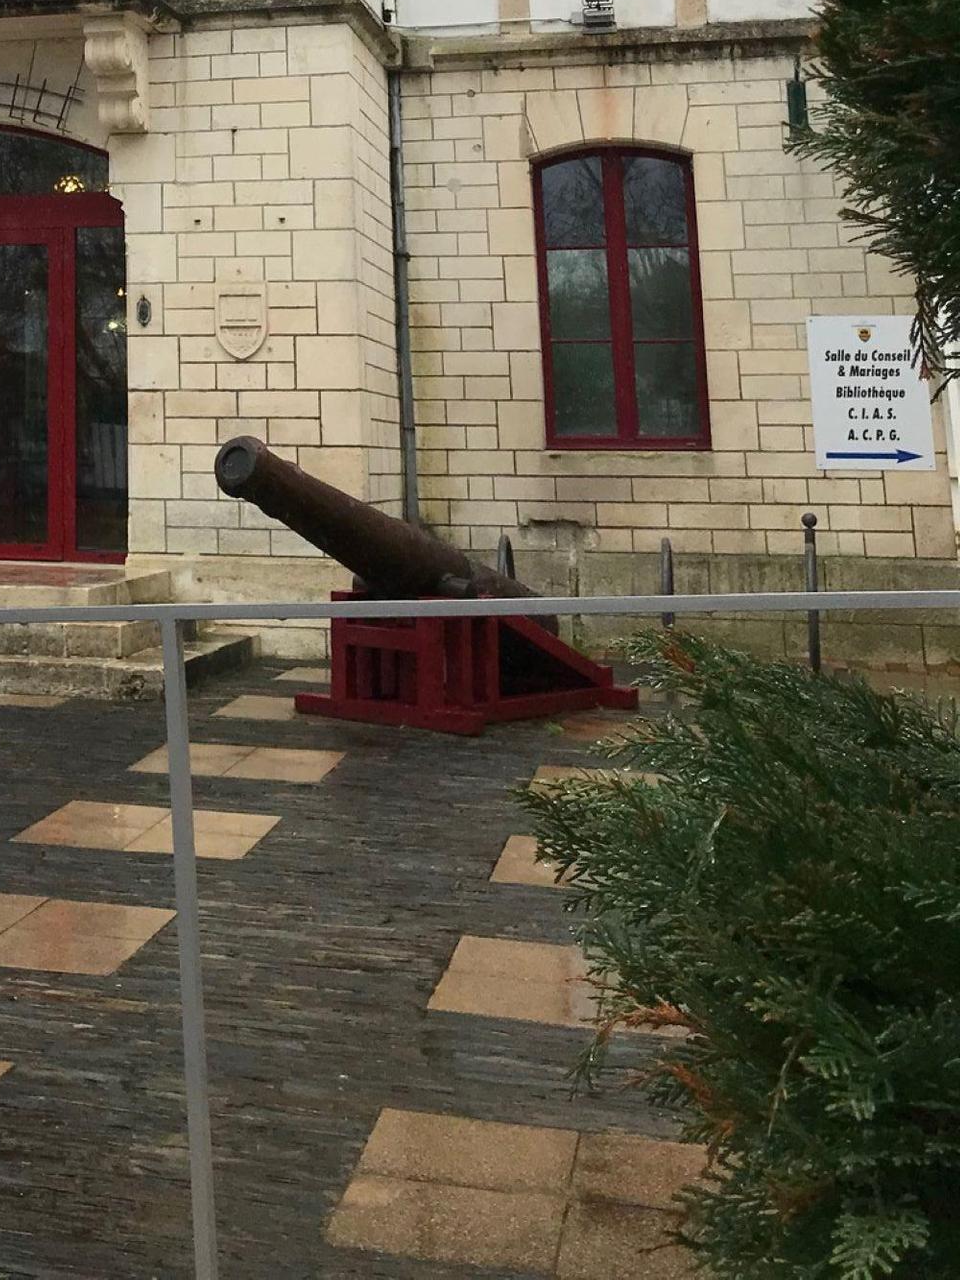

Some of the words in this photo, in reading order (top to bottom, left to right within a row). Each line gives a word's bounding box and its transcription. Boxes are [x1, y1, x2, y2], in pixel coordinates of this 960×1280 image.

[825, 350, 851, 362] Salle
[854, 350, 868, 362] du
[871, 349, 911, 362] Conseil
[837, 366, 846, 377] &
[849, 365, 901, 380] Mariages
[836, 386, 906, 401] Bibliothèque
[848, 408, 858, 420] C.
[862, 408, 869, 420] I.
[872, 408, 883, 420] A.
[887, 408, 897, 420] S.
[848, 429, 859, 441] A.
[862, 429, 872, 441] C.
[876, 429, 885, 441] P.
[889, 429, 900, 441] G.
